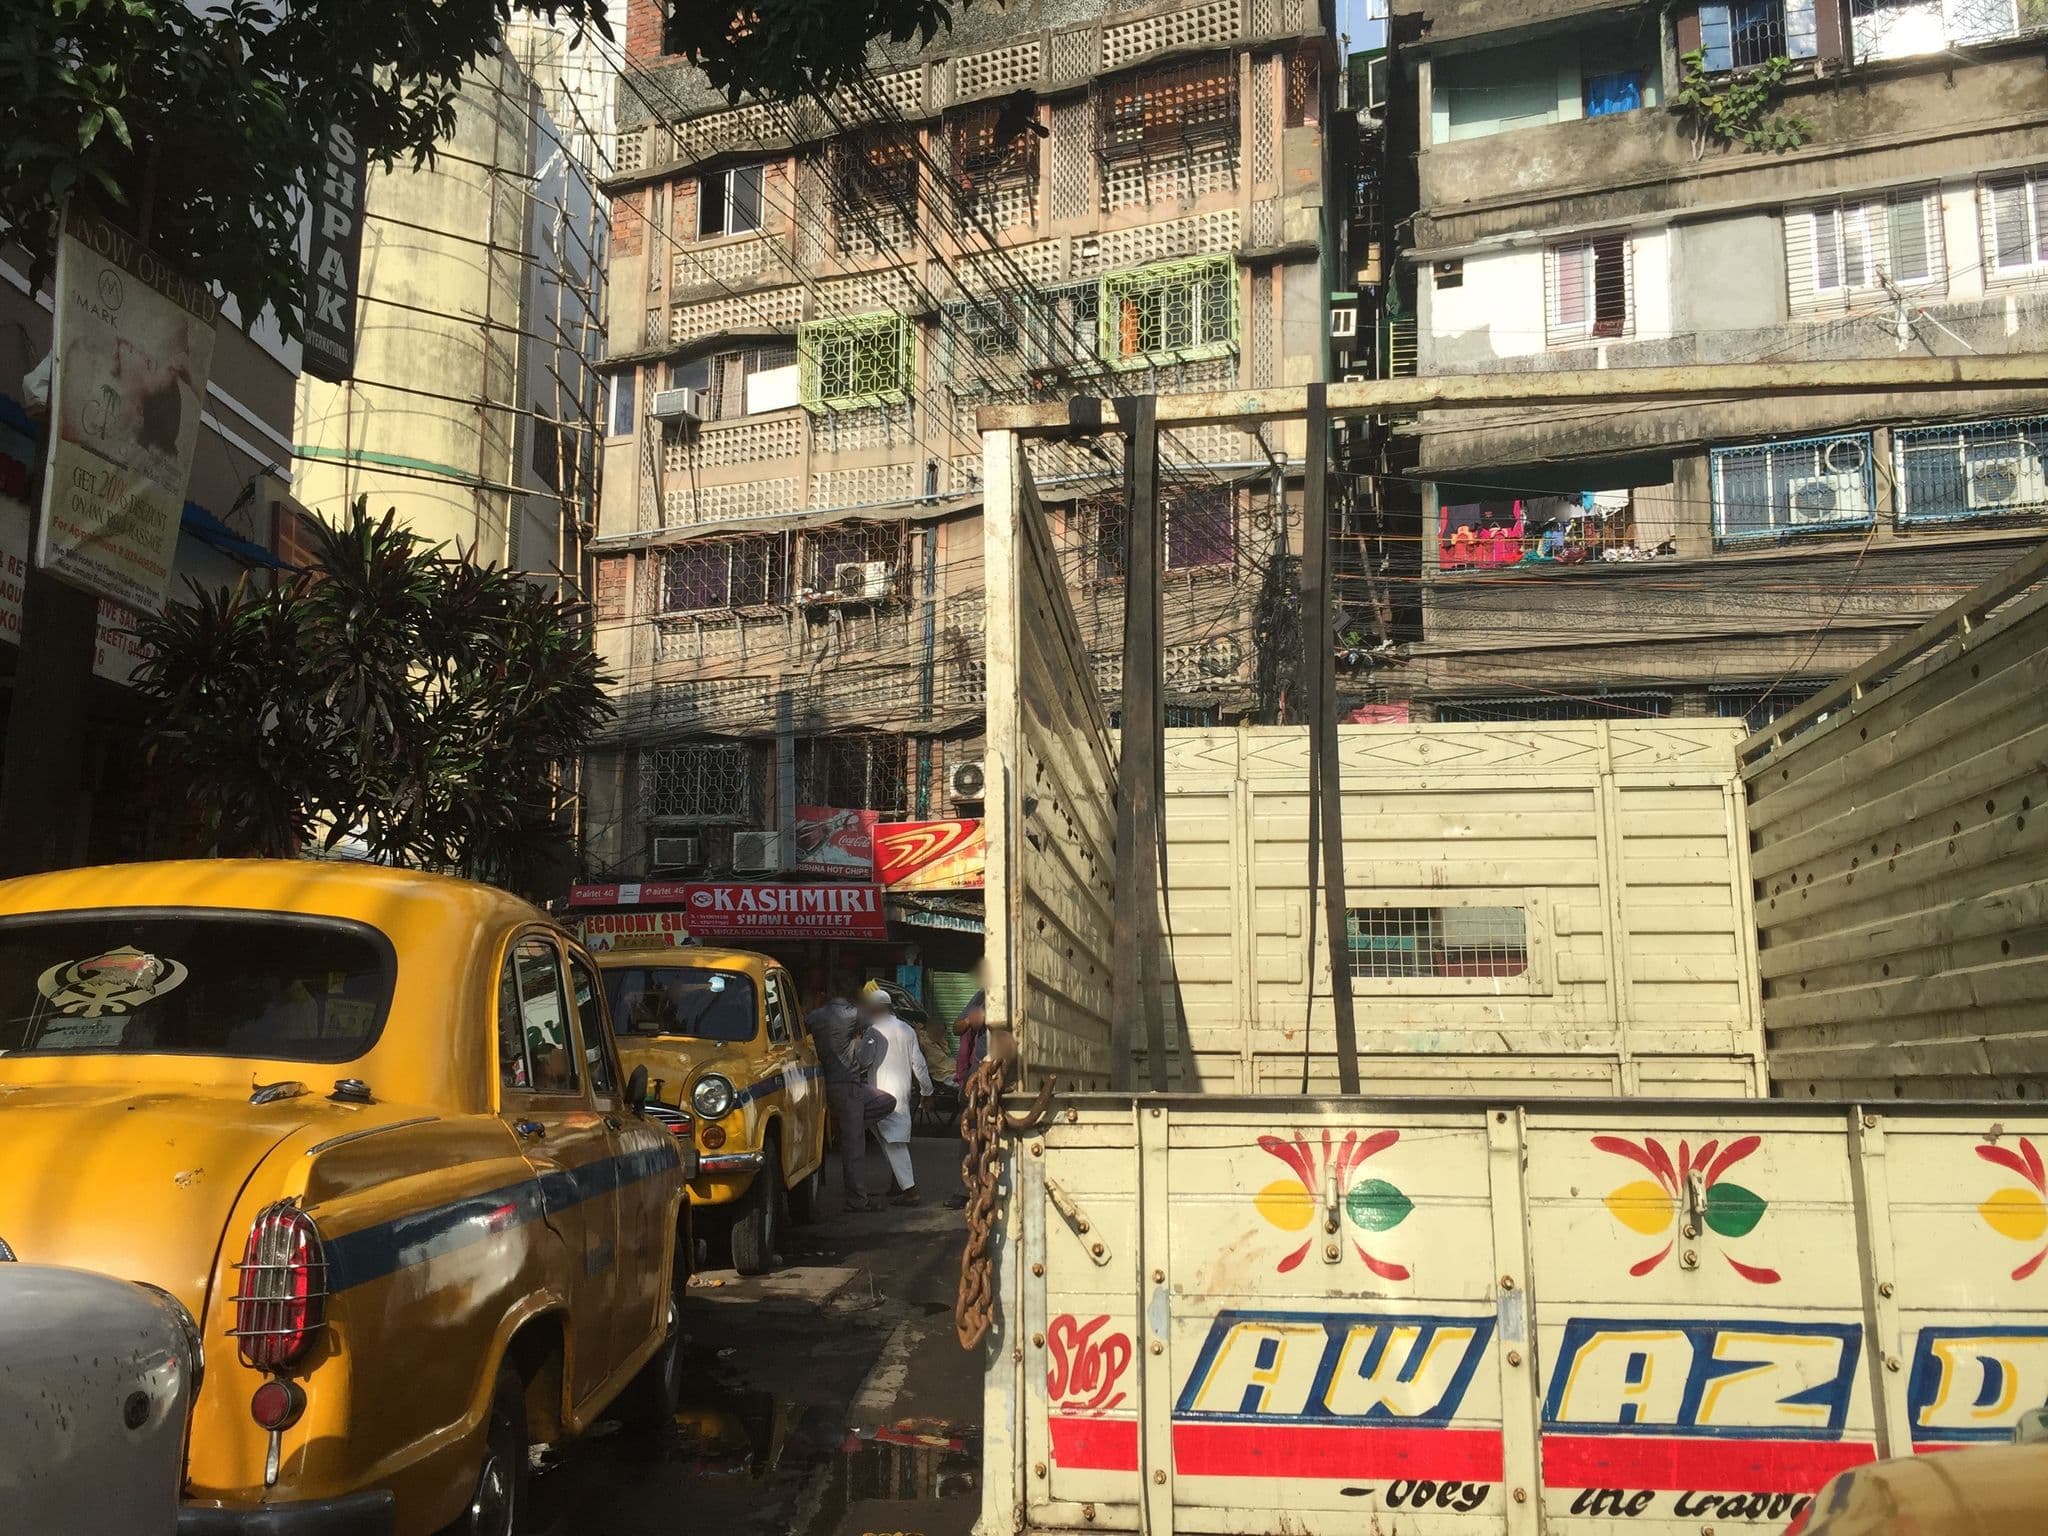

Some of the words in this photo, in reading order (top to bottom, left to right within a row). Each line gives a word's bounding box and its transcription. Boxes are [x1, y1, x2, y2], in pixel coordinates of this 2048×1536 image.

[77, 215, 132, 268] NOW
[138, 253, 216, 322] OPENED
[76, 295, 118, 329] MARK
[72, 466, 97, 495] GET
[796, 863, 825, 873] RISHNA
[826, 865, 844, 874] HOT
[713, 888, 877, 913] KASHMIRI
[586, 914, 657, 934] ECONOMY
[736, 914, 791, 926] SHAWL
[795, 914, 853, 926] OUTLET
[813, 929, 856, 937] KOLKATA
